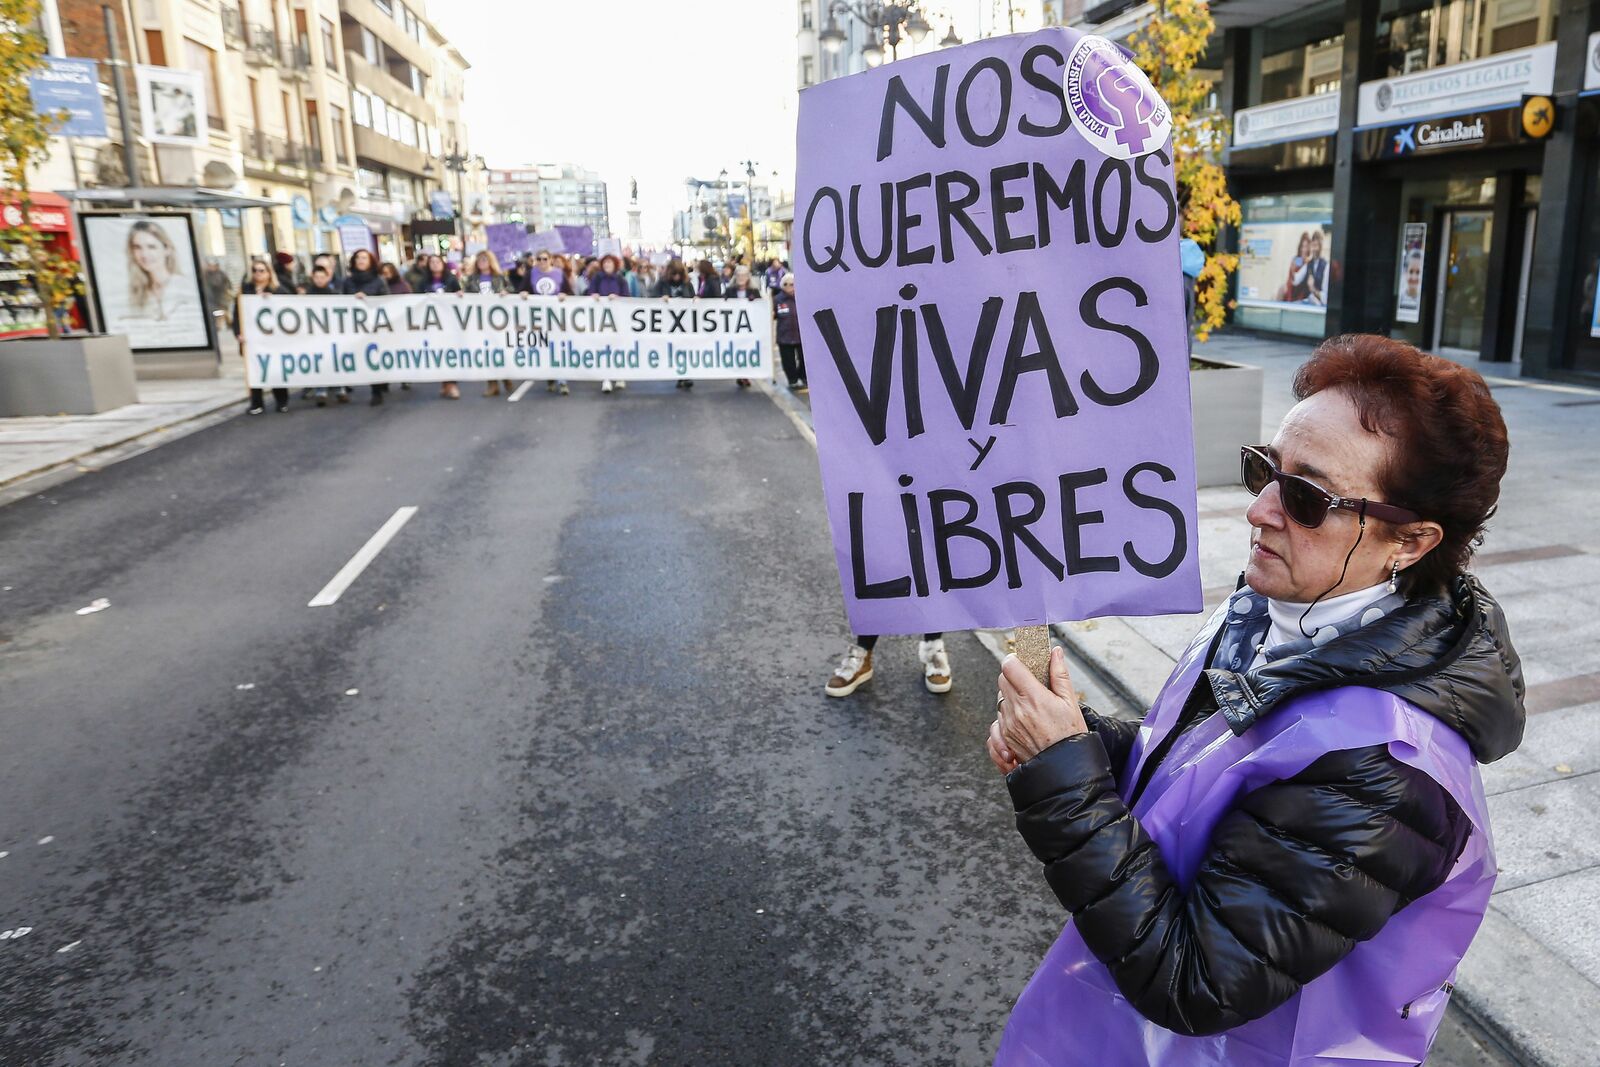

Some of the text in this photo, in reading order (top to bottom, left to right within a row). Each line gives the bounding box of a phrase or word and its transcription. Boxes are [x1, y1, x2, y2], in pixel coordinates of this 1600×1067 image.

[1394, 75, 1461, 99] RECURSOS
[1466, 60, 1533, 88] LEGALES
[876, 44, 1074, 162] NOS
[1079, 111, 1107, 138] PARA
[1417, 117, 1485, 146] CaixaBank
[802, 149, 1177, 273] QUEREMOS
[256, 307, 393, 335] CONTRA
[406, 305, 443, 331] LA
[453, 305, 617, 333] VIOLENCIA
[631, 308, 753, 334] SEXISTA
[256, 340, 761, 383] y por la Convivencia en Libertad e Igualdad
